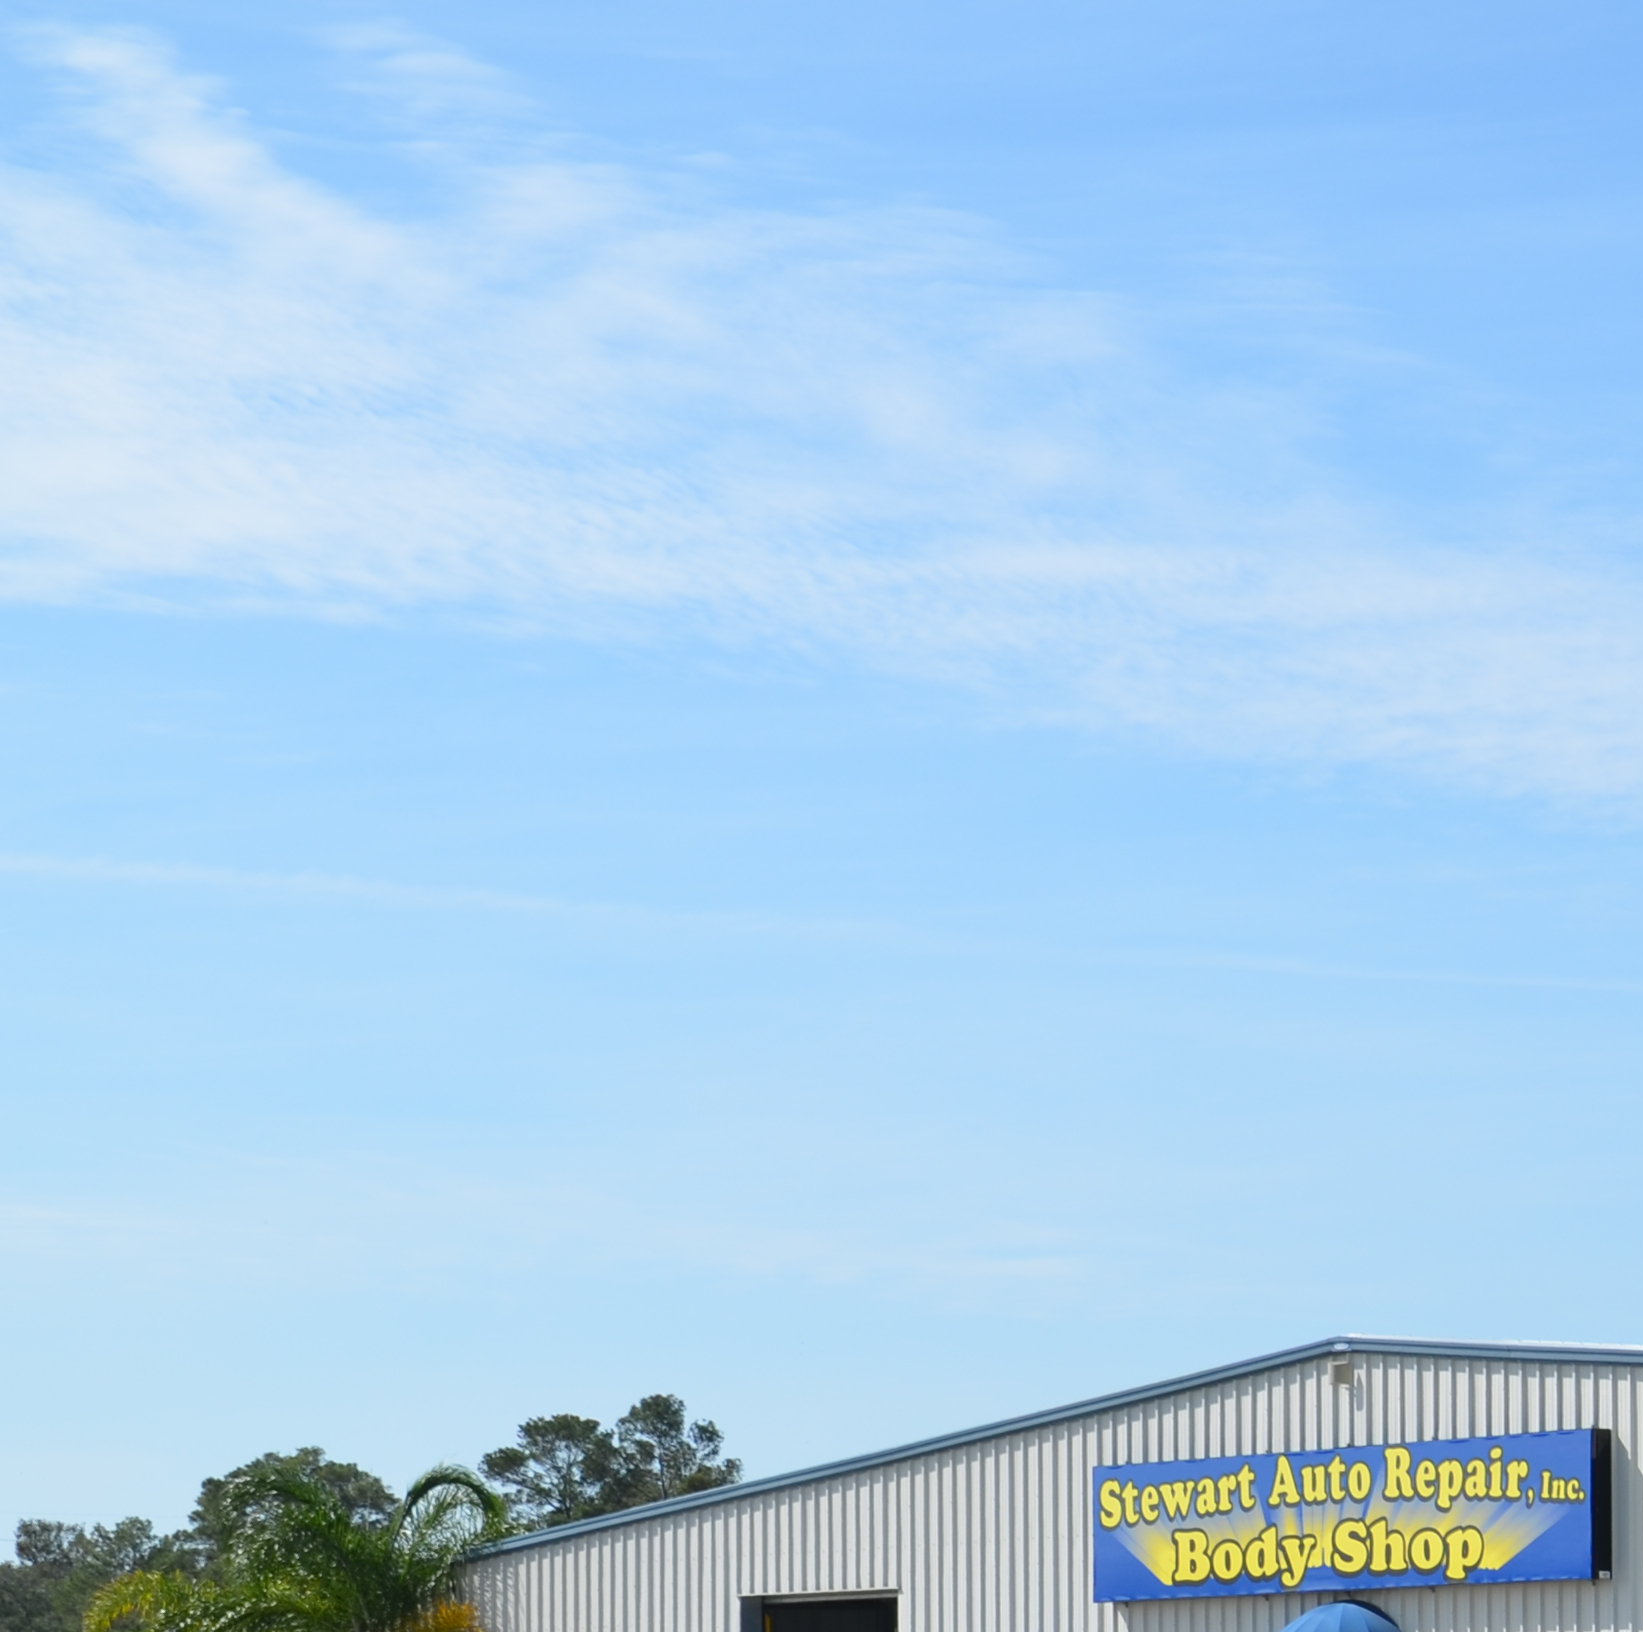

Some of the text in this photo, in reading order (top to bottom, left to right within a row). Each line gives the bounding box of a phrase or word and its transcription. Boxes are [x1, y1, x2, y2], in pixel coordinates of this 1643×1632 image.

[1100, 1446, 1585, 1528] Stewart Auto Repair, Inc.
[1173, 1517, 1484, 1588] Body Shop
